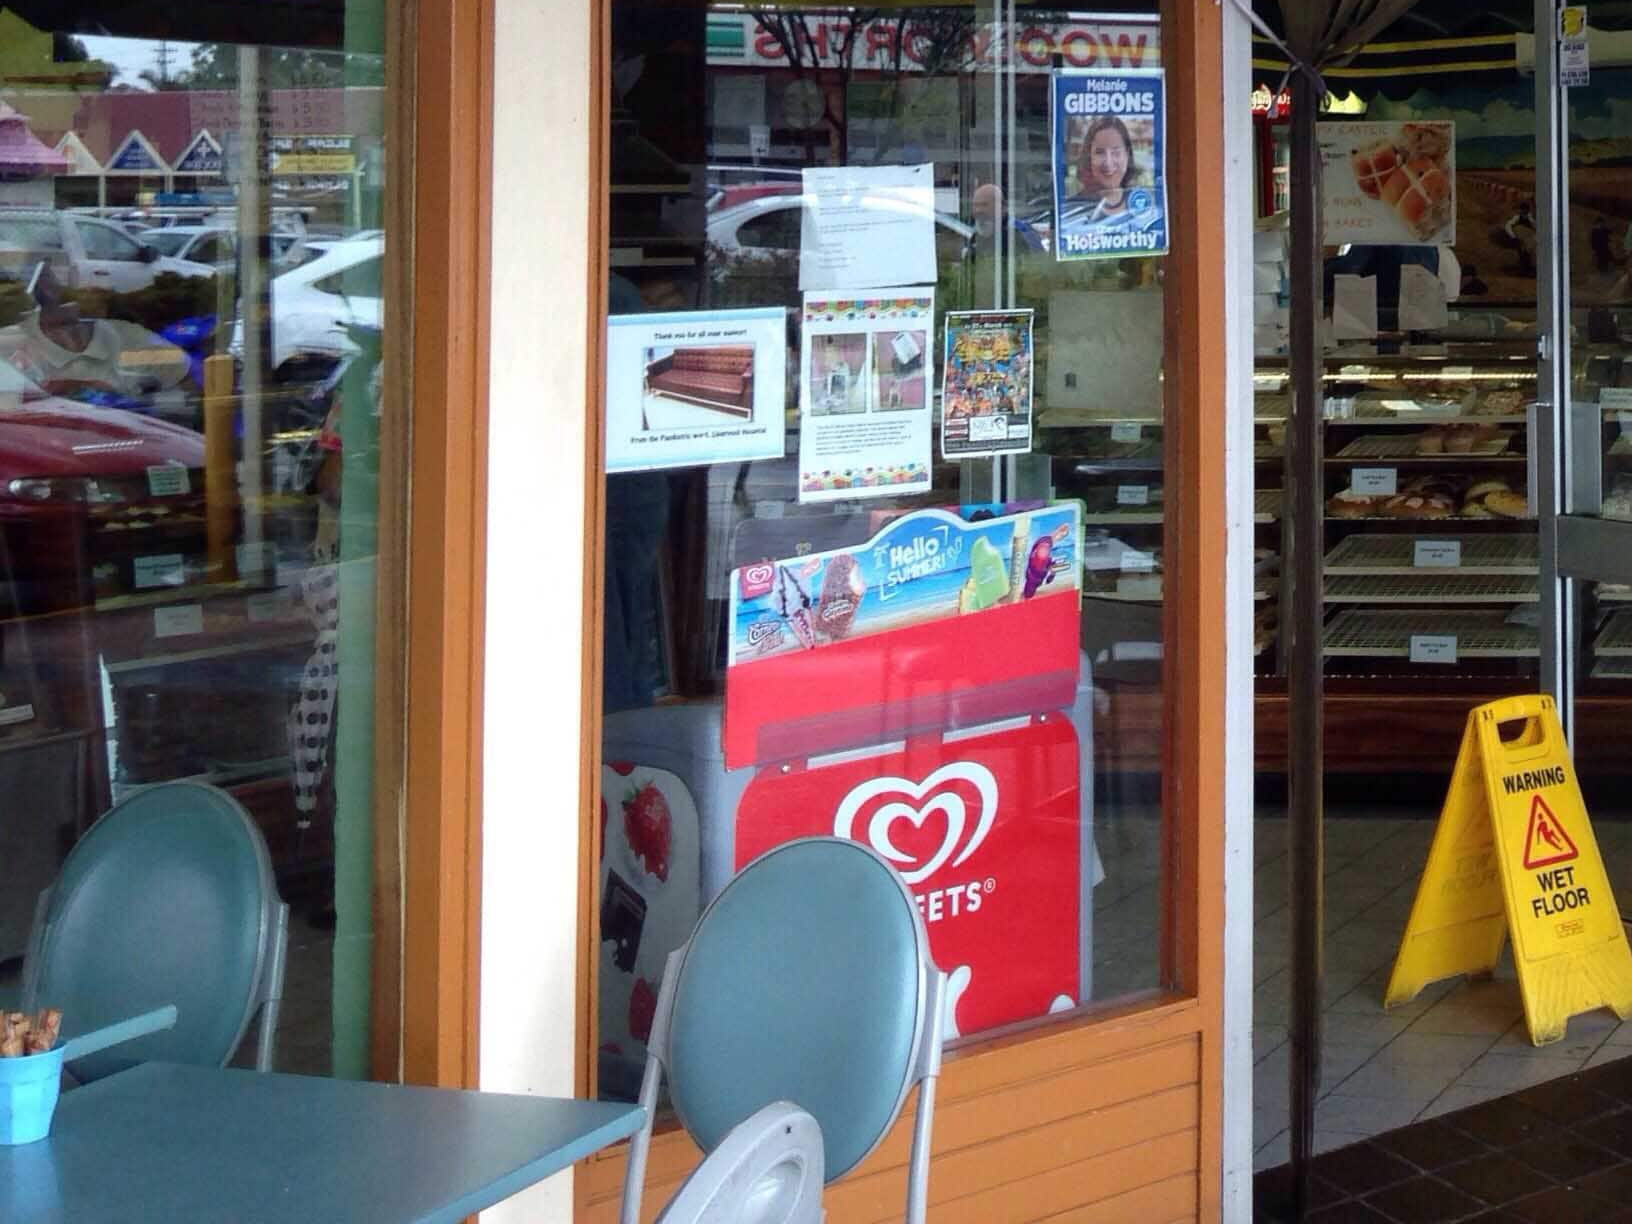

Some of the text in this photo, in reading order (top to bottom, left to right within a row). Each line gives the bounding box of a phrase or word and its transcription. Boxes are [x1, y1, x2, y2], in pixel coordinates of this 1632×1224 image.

[1087, 79, 1128, 92] Melanie
[1064, 92, 1154, 114] GIBBONS
[1066, 230, 1157, 251] Holsworthy
[890, 536, 939, 568] Hello
[887, 555, 945, 587] SUMMER!
[1503, 766, 1565, 794] WARNING
[1536, 866, 1575, 893] WET
[1532, 888, 1590, 918] FLOOR
